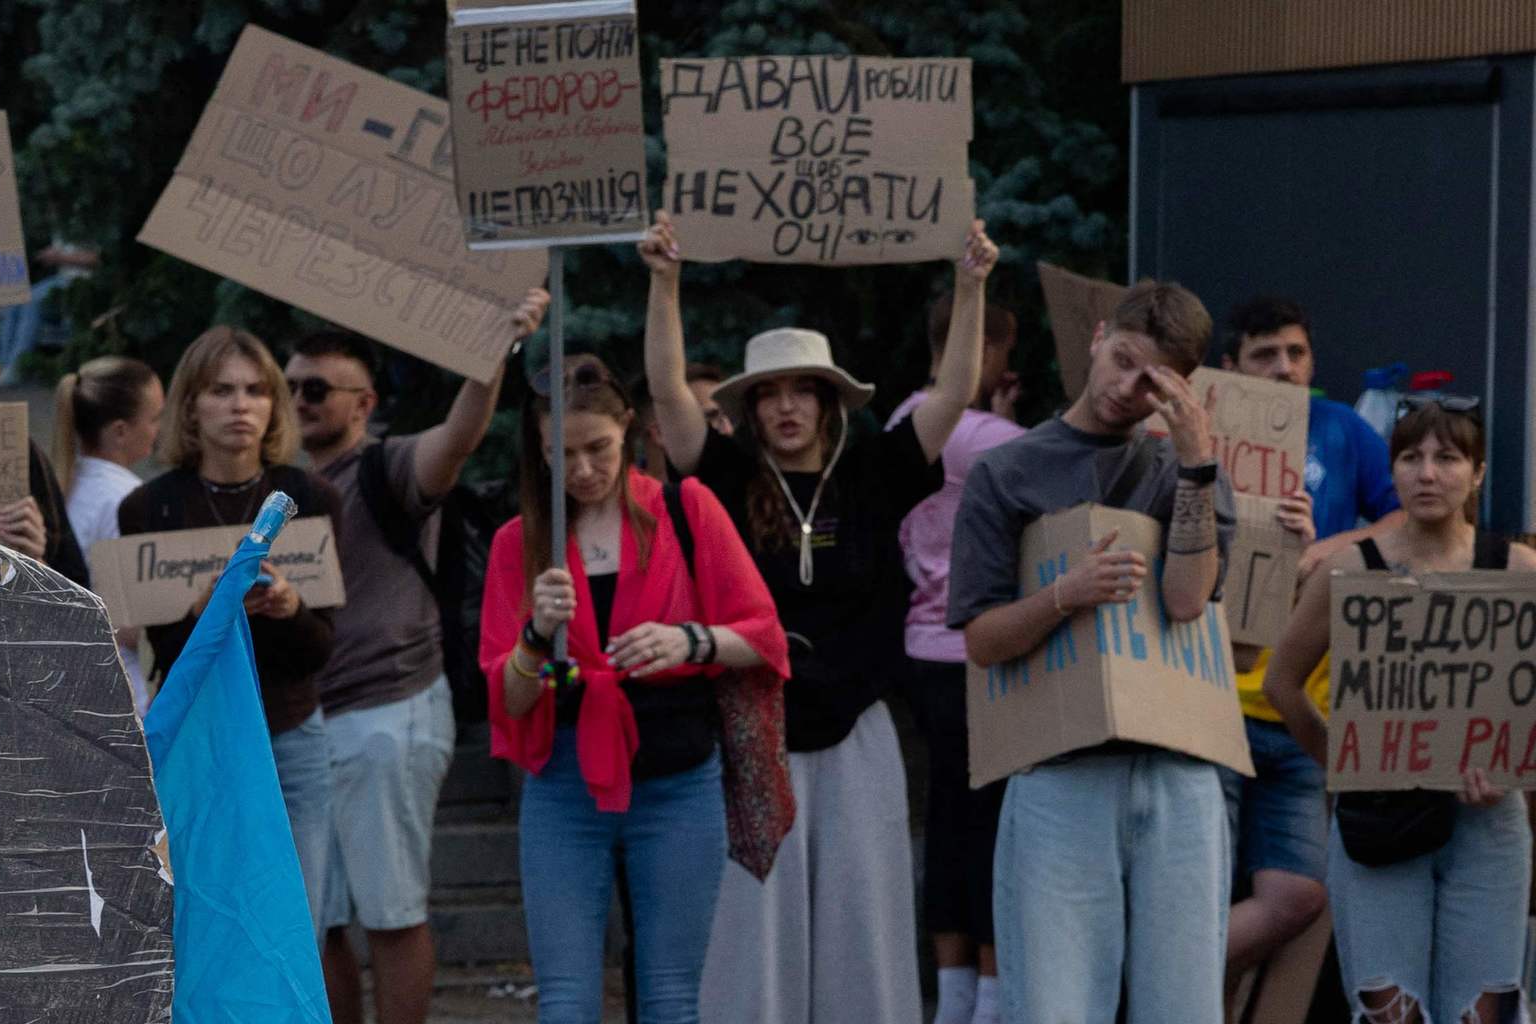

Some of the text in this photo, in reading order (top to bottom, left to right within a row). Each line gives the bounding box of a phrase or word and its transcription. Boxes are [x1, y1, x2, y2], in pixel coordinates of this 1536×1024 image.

[464, 28, 506, 72] ЦЕ
[516, 27, 549, 66] НЕ
[252, 52, 359, 134] МИ
[664, 56, 959, 114] ДАВАЙ РОБИТИ
[220, 112, 324, 192] ЩО
[770, 116, 873, 160] ВСЕ
[672, 170, 943, 224] НЕ ХОВАТИ
[1335, 719, 1360, 774] А
[1380, 718, 1438, 773] НЕ
